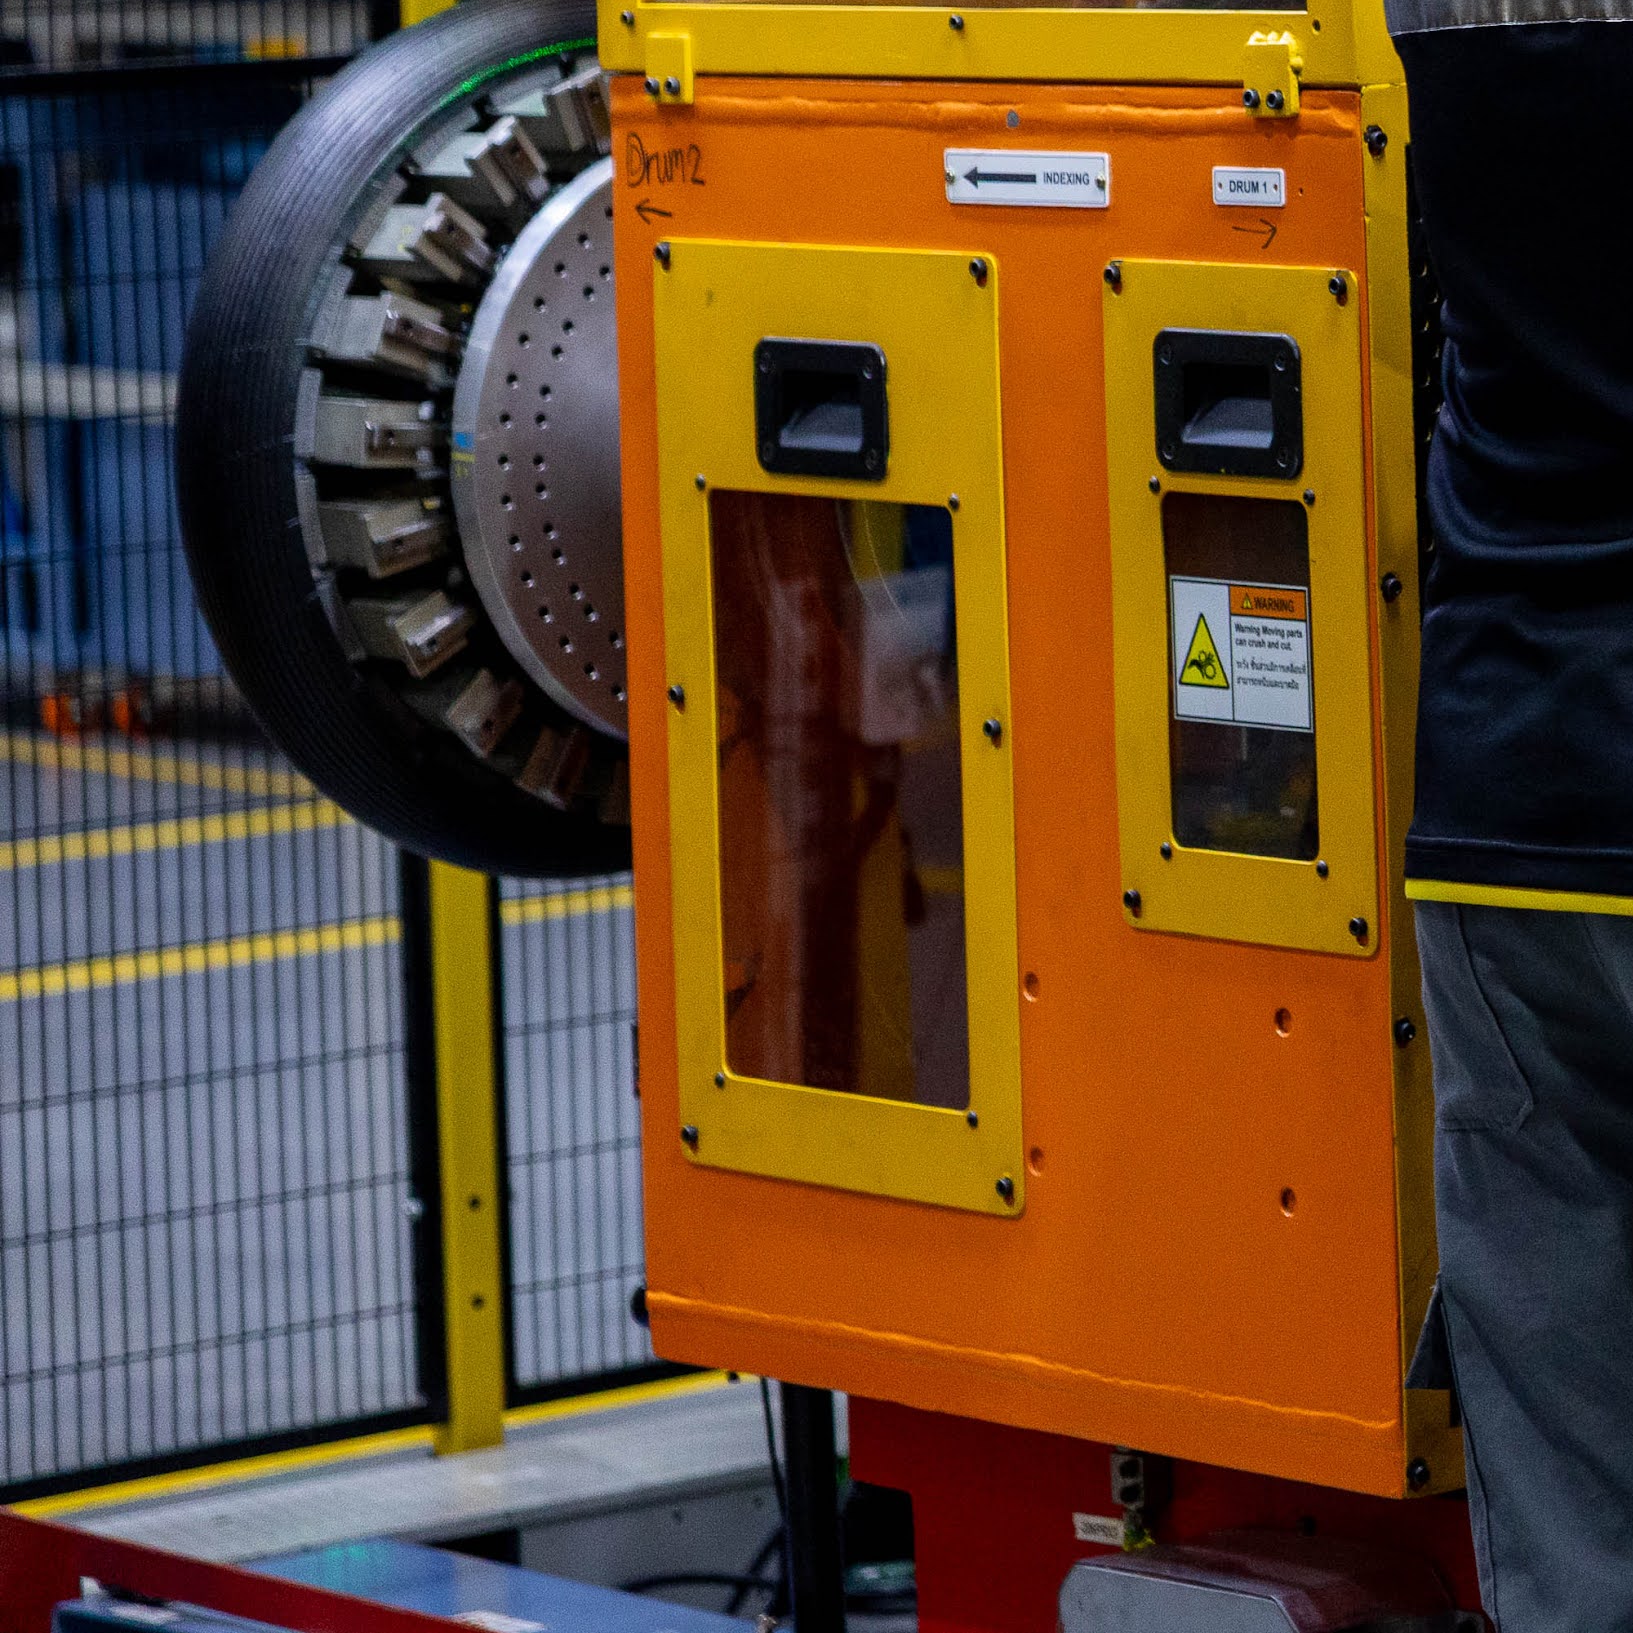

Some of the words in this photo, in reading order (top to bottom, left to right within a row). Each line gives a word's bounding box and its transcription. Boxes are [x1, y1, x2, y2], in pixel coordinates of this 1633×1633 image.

[1042, 171, 1090, 186] INDEXING
[1229, 180, 1259, 194] DRUM
[1262, 181, 1268, 194] 1
[1254, 597, 1295, 613] WARNING
[1234, 623, 1261, 636] Warning
[1261, 626, 1285, 639] Moving
[1286, 629, 1303, 639] parts
[1235, 638, 1247, 646] can
[1248, 639, 1266, 648] crush
[1267, 640, 1280, 649] and
